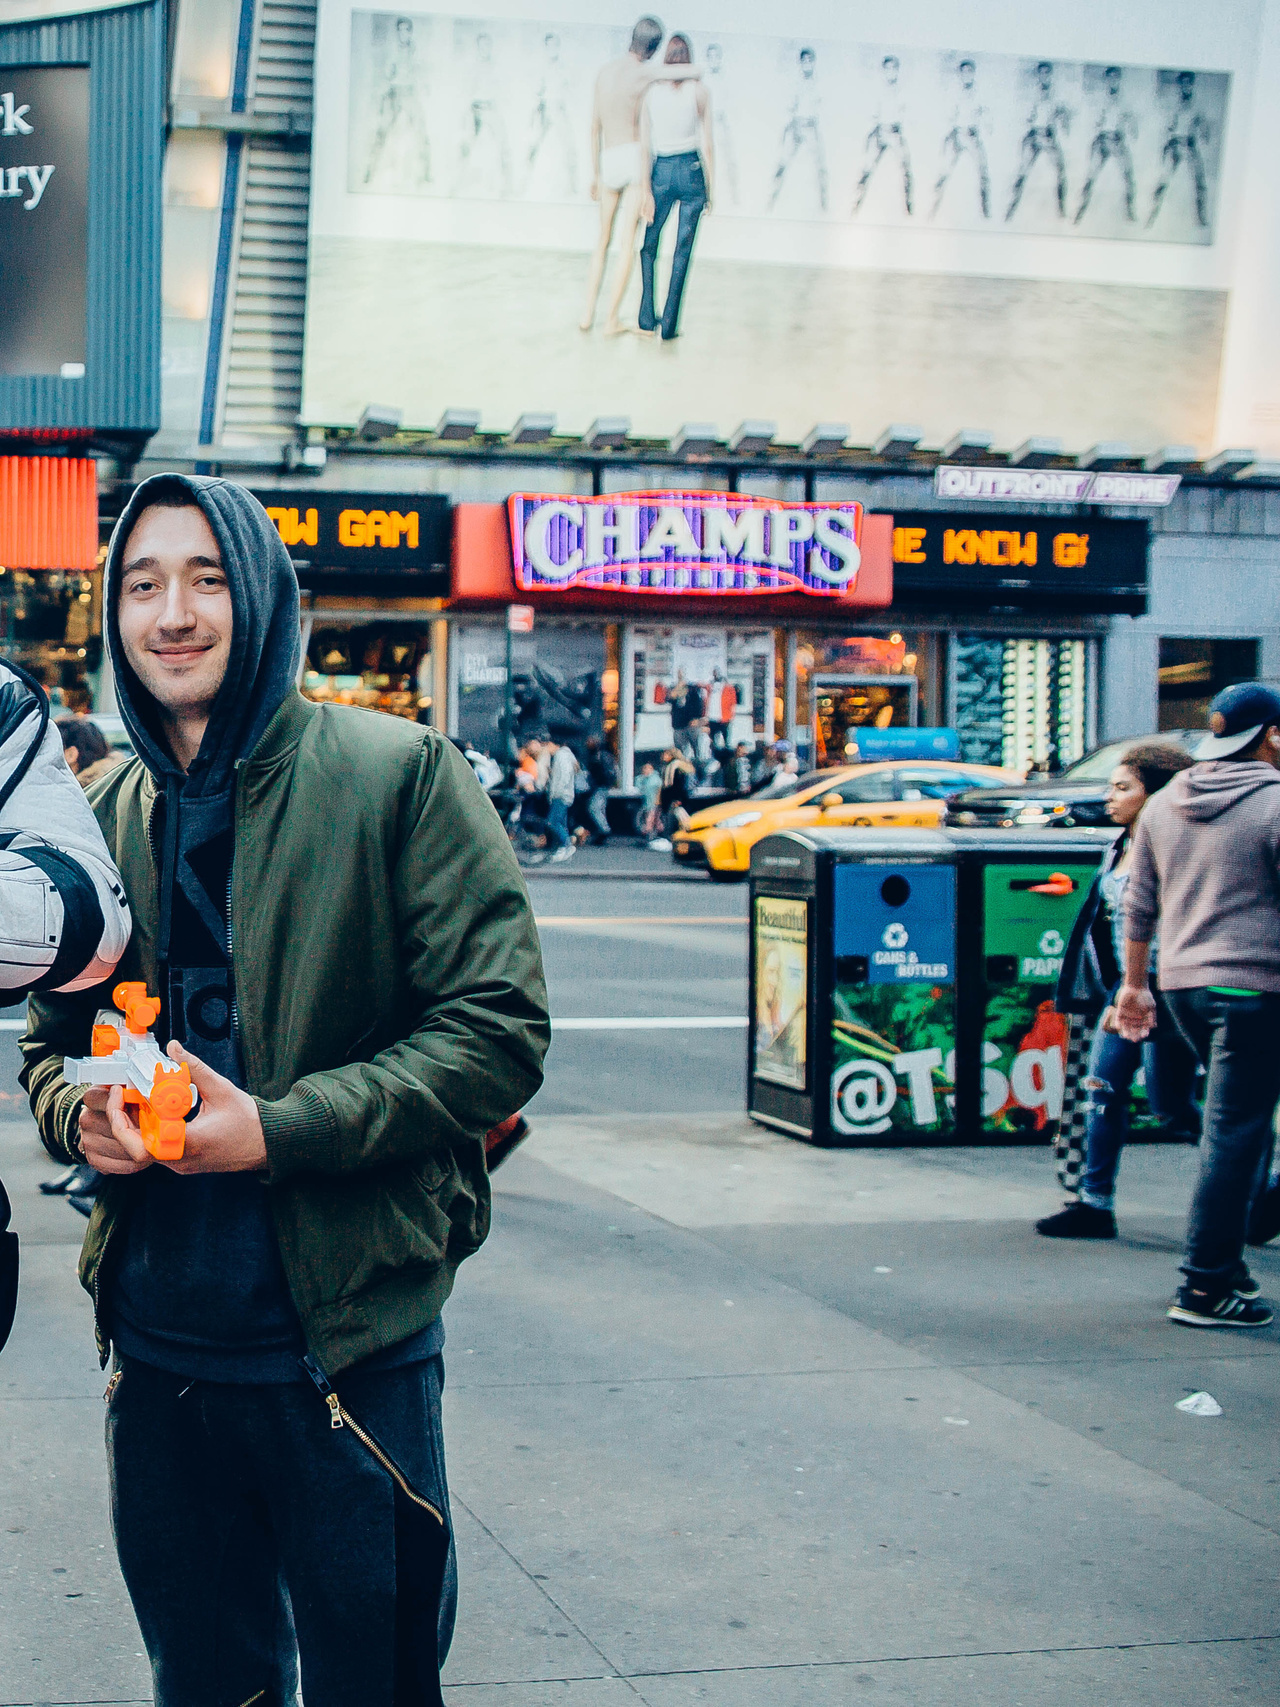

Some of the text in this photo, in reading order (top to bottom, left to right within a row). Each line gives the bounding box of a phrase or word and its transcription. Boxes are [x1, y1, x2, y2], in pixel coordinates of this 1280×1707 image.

[943, 469, 1083, 499] OUTFRONT
[524, 500, 862, 585] CHAMPS
[872, 950, 907, 966] CANS
[1022, 956, 1062, 977] PAP
[895, 962, 949, 978] BOTTLES
